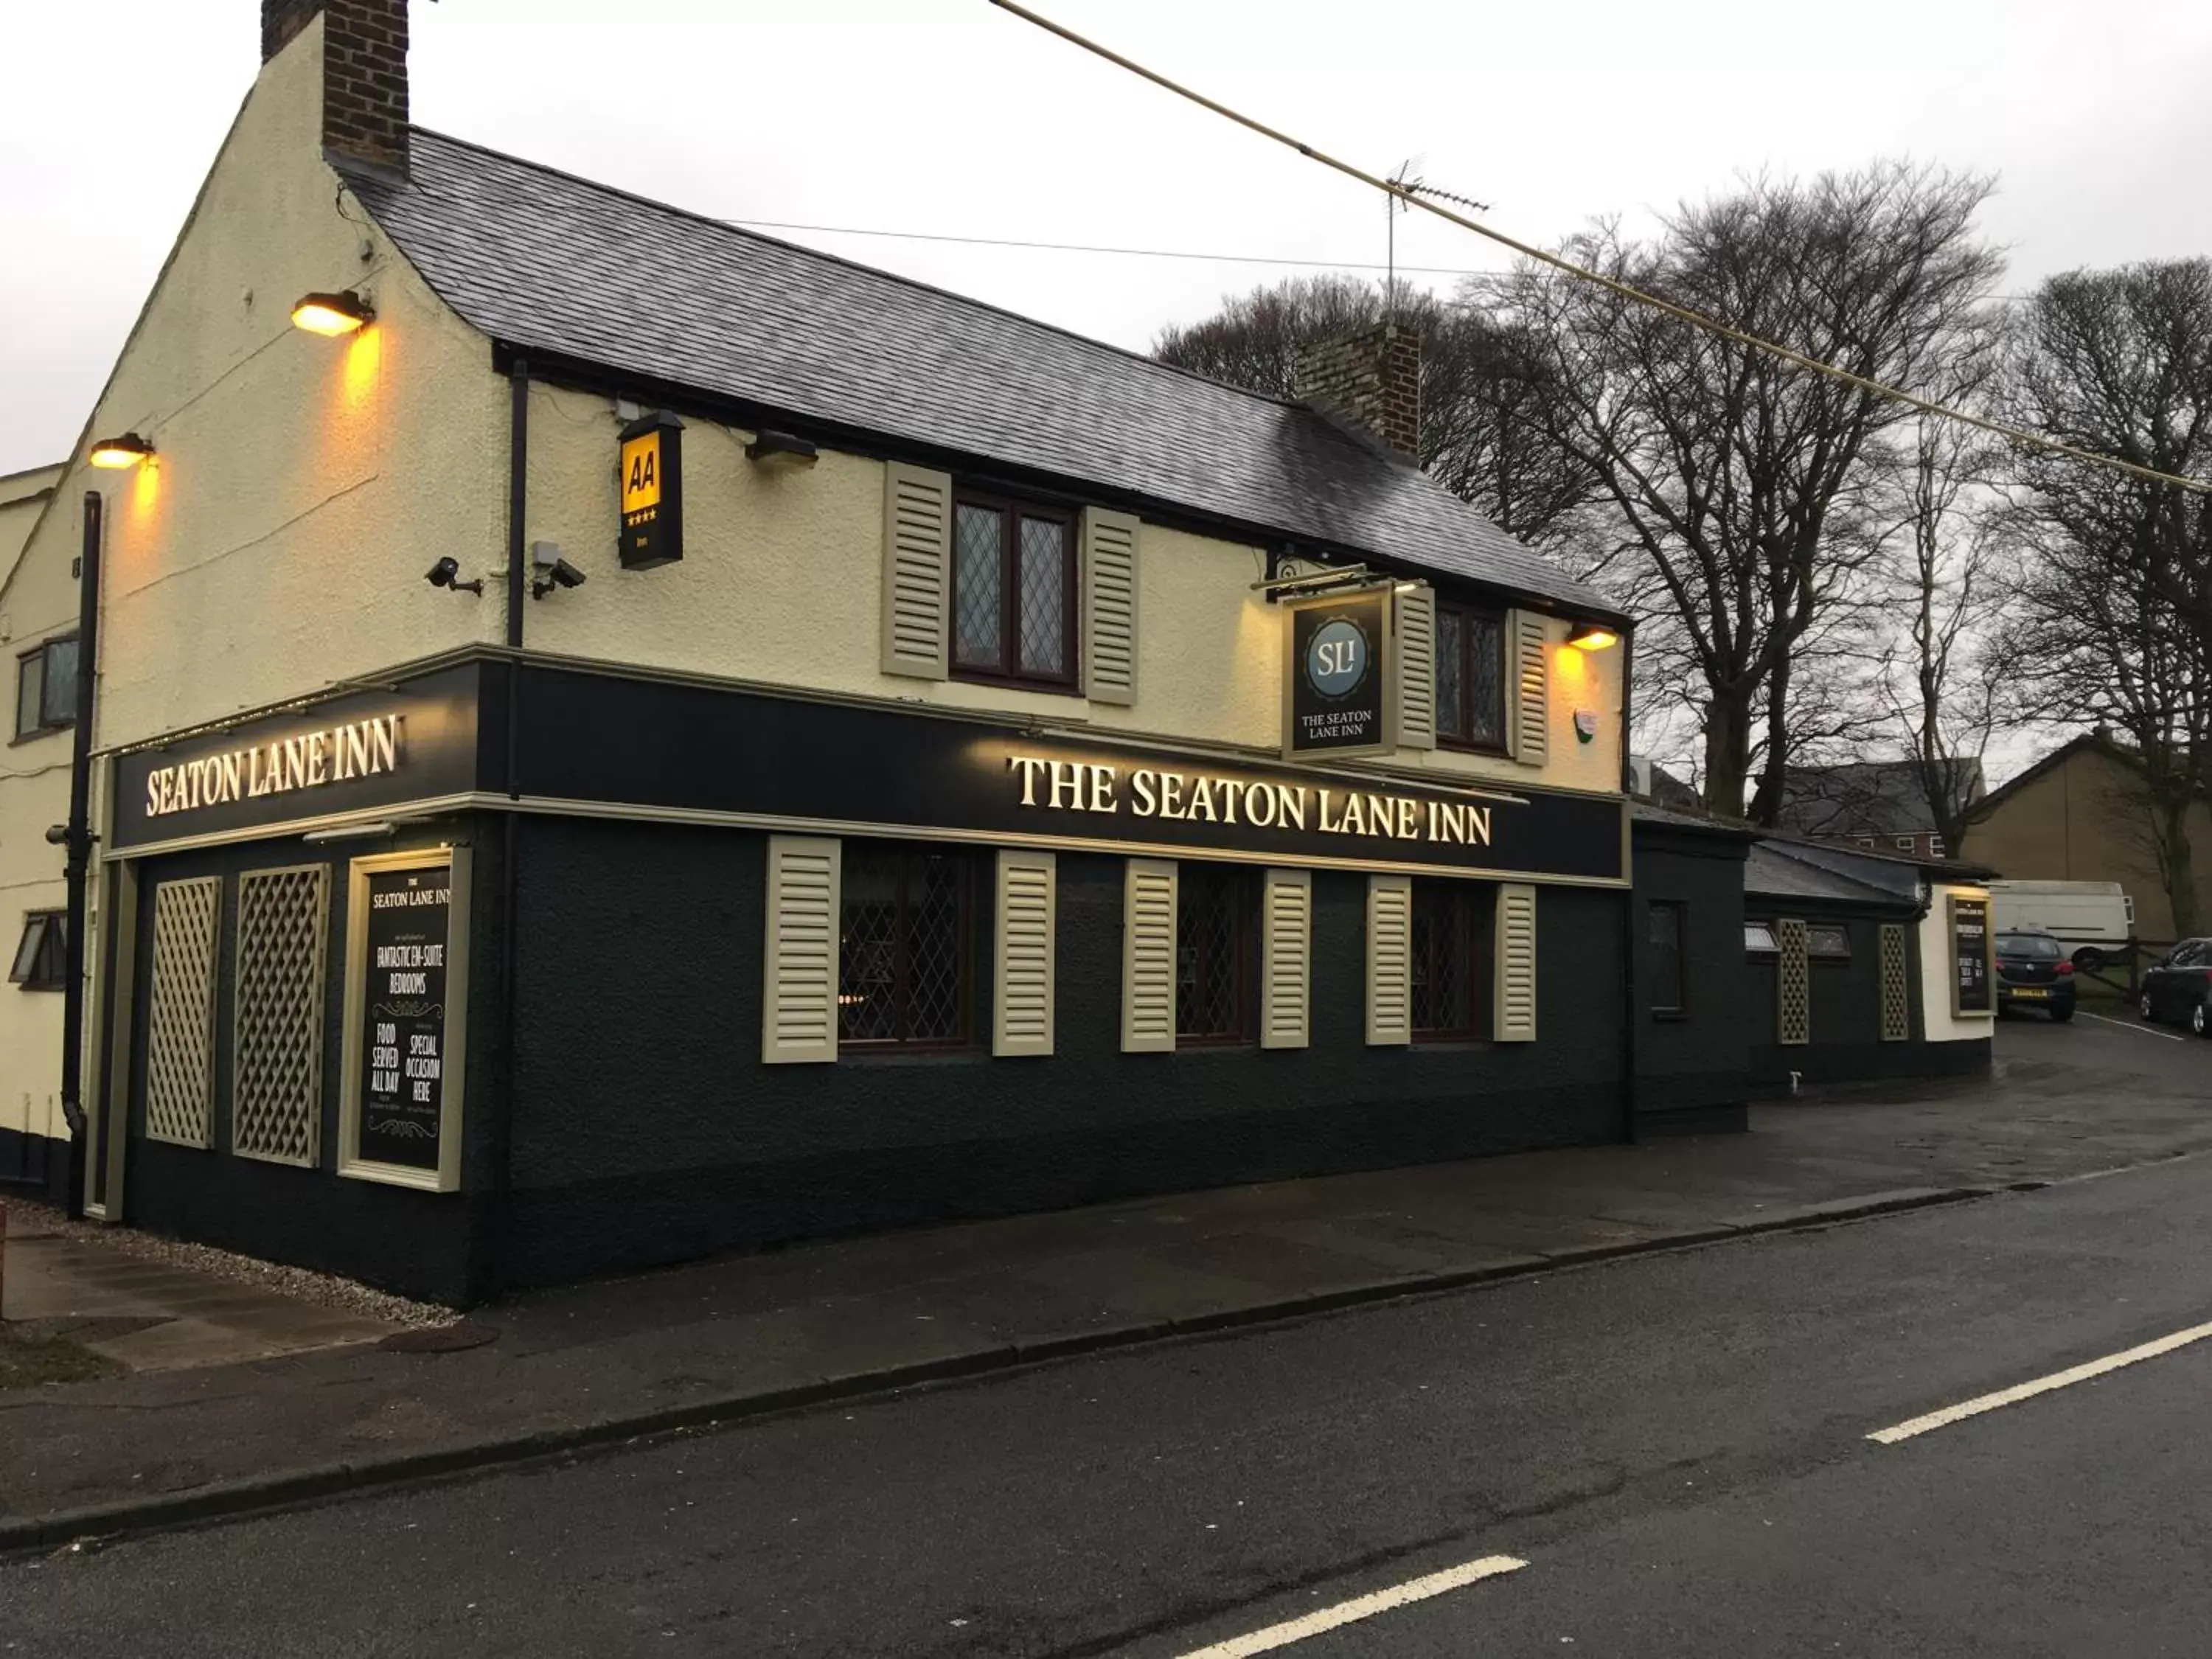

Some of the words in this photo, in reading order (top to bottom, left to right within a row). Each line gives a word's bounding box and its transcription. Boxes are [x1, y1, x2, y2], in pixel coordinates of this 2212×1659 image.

[628, 450, 655, 495] AA
[1317, 639, 1355, 676] SLI
[1302, 714, 1324, 727] THE
[1326, 709, 1372, 724] SEATON
[1310, 726, 1340, 740] LANE
[1341, 723, 1364, 737] INN
[146, 751, 241, 817] SEATON
[247, 730, 326, 798] LANE
[333, 714, 397, 780] INN
[1011, 756, 1118, 814] THE
[1131, 769, 1306, 831] SEATON
[1316, 789, 1420, 841] LANE
[1427, 802, 1492, 847] INN
[373, 891, 408, 909] SEATON
[409, 889, 434, 906] LANE
[377, 945, 411, 968] FANTASTIC
[411, 944, 443, 967] EN-SUITE
[389, 973, 426, 995] BEDROOMS
[377, 1023, 396, 1044] FOOD
[410, 1034, 437, 1055] SPECIAL
[372, 1046, 399, 1068] SERVED
[406, 1057, 440, 1079] OCCASION
[371, 1070, 383, 1092] ALL
[385, 1071, 400, 1093] DAY
[413, 1080, 431, 1102] HERE
